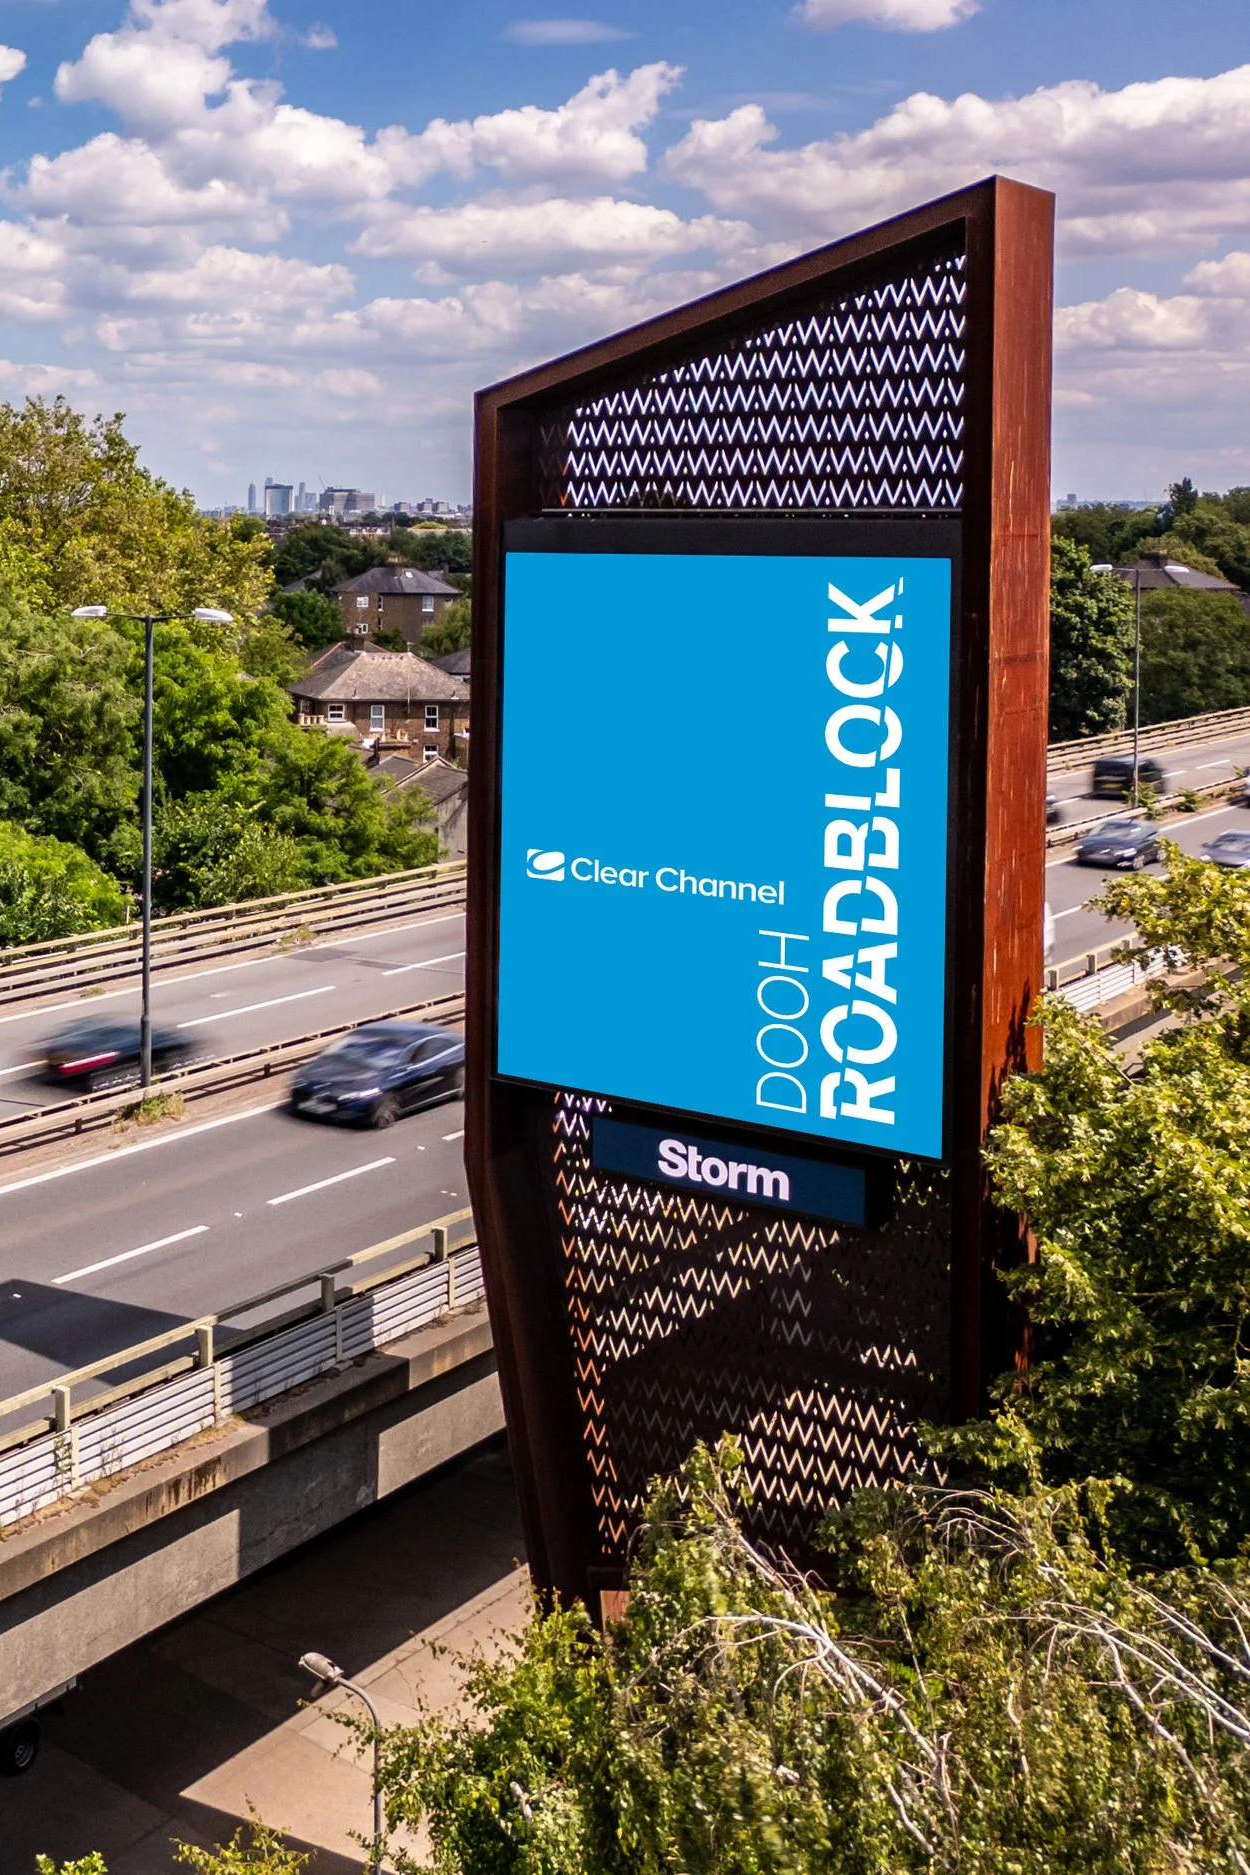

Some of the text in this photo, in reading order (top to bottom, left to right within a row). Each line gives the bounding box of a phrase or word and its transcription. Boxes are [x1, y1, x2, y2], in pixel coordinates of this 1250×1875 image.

[570, 857, 785, 906] Clear Channel
[819, 576, 904, 1125] ROADBLOCK
[756, 929, 810, 1114] DOOH
[656, 1138, 790, 1202] Storm
